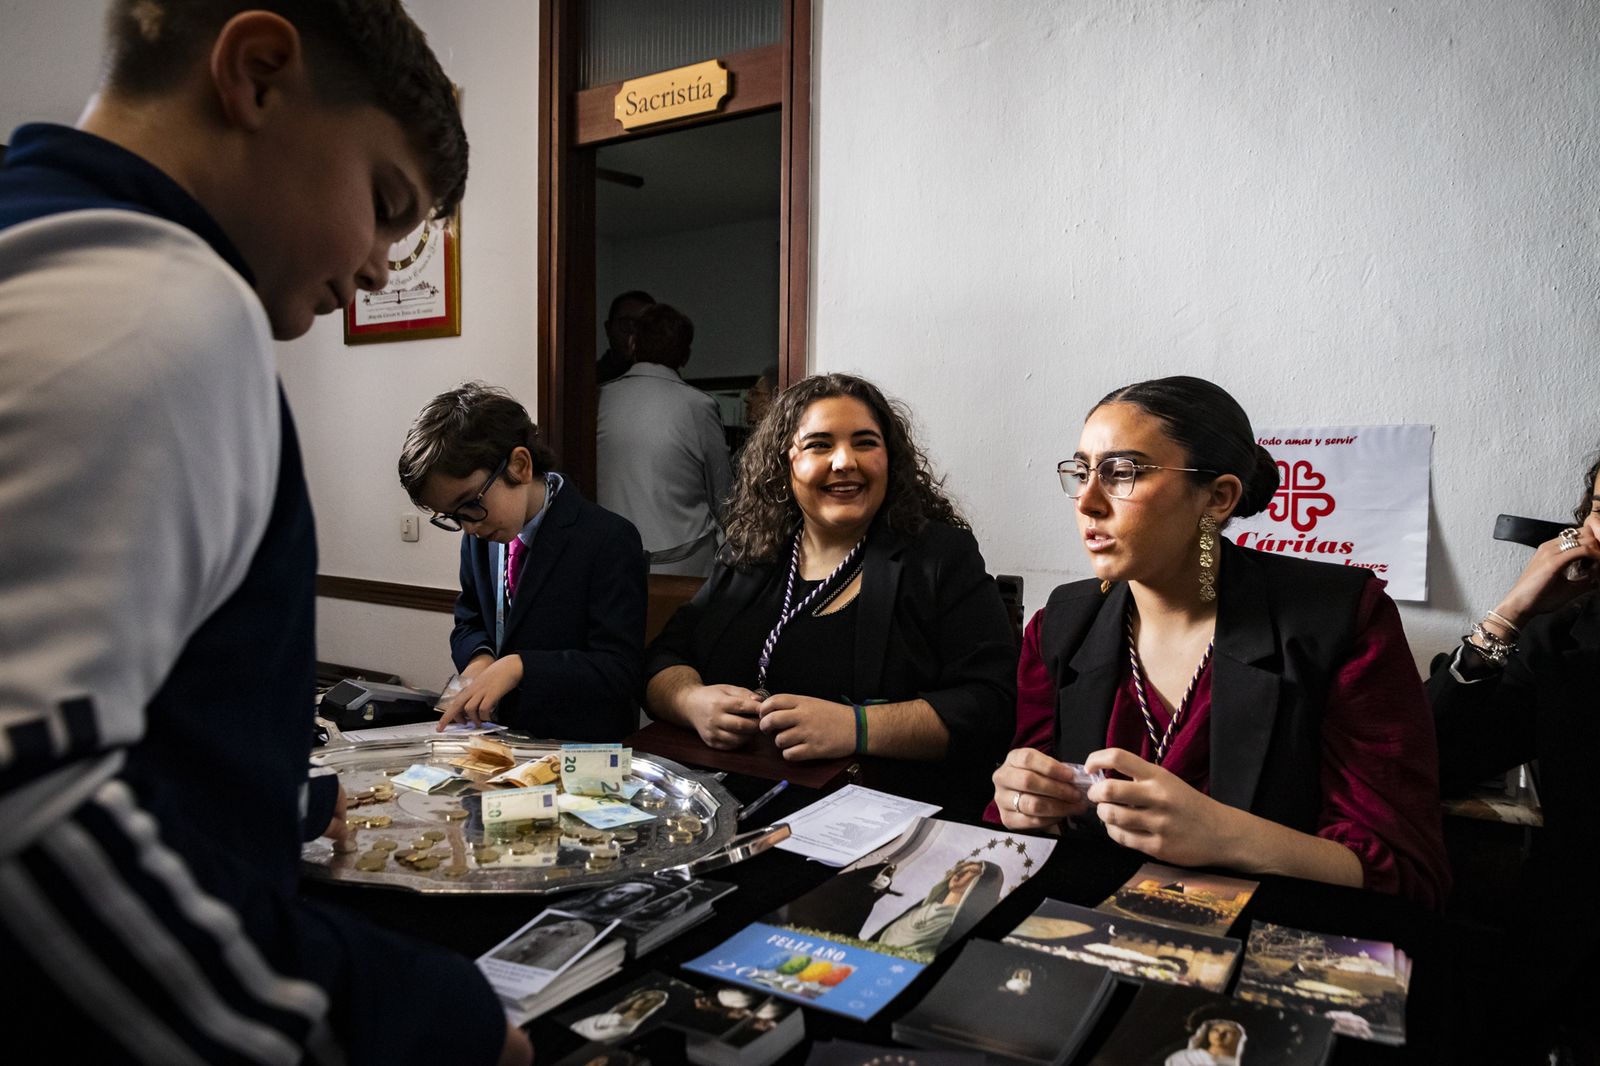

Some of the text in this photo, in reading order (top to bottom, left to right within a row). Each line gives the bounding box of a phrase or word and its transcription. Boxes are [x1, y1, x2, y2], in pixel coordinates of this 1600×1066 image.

[625, 75, 713, 116] Sacristía
[1257, 436, 1282, 446] todo
[1285, 437, 1312, 446] amar
[1315, 437, 1322, 447] y
[1236, 532, 1355, 555] Cáritas
[564, 756, 577, 773] 20
[766, 934, 847, 962] FELIZ AÑO
